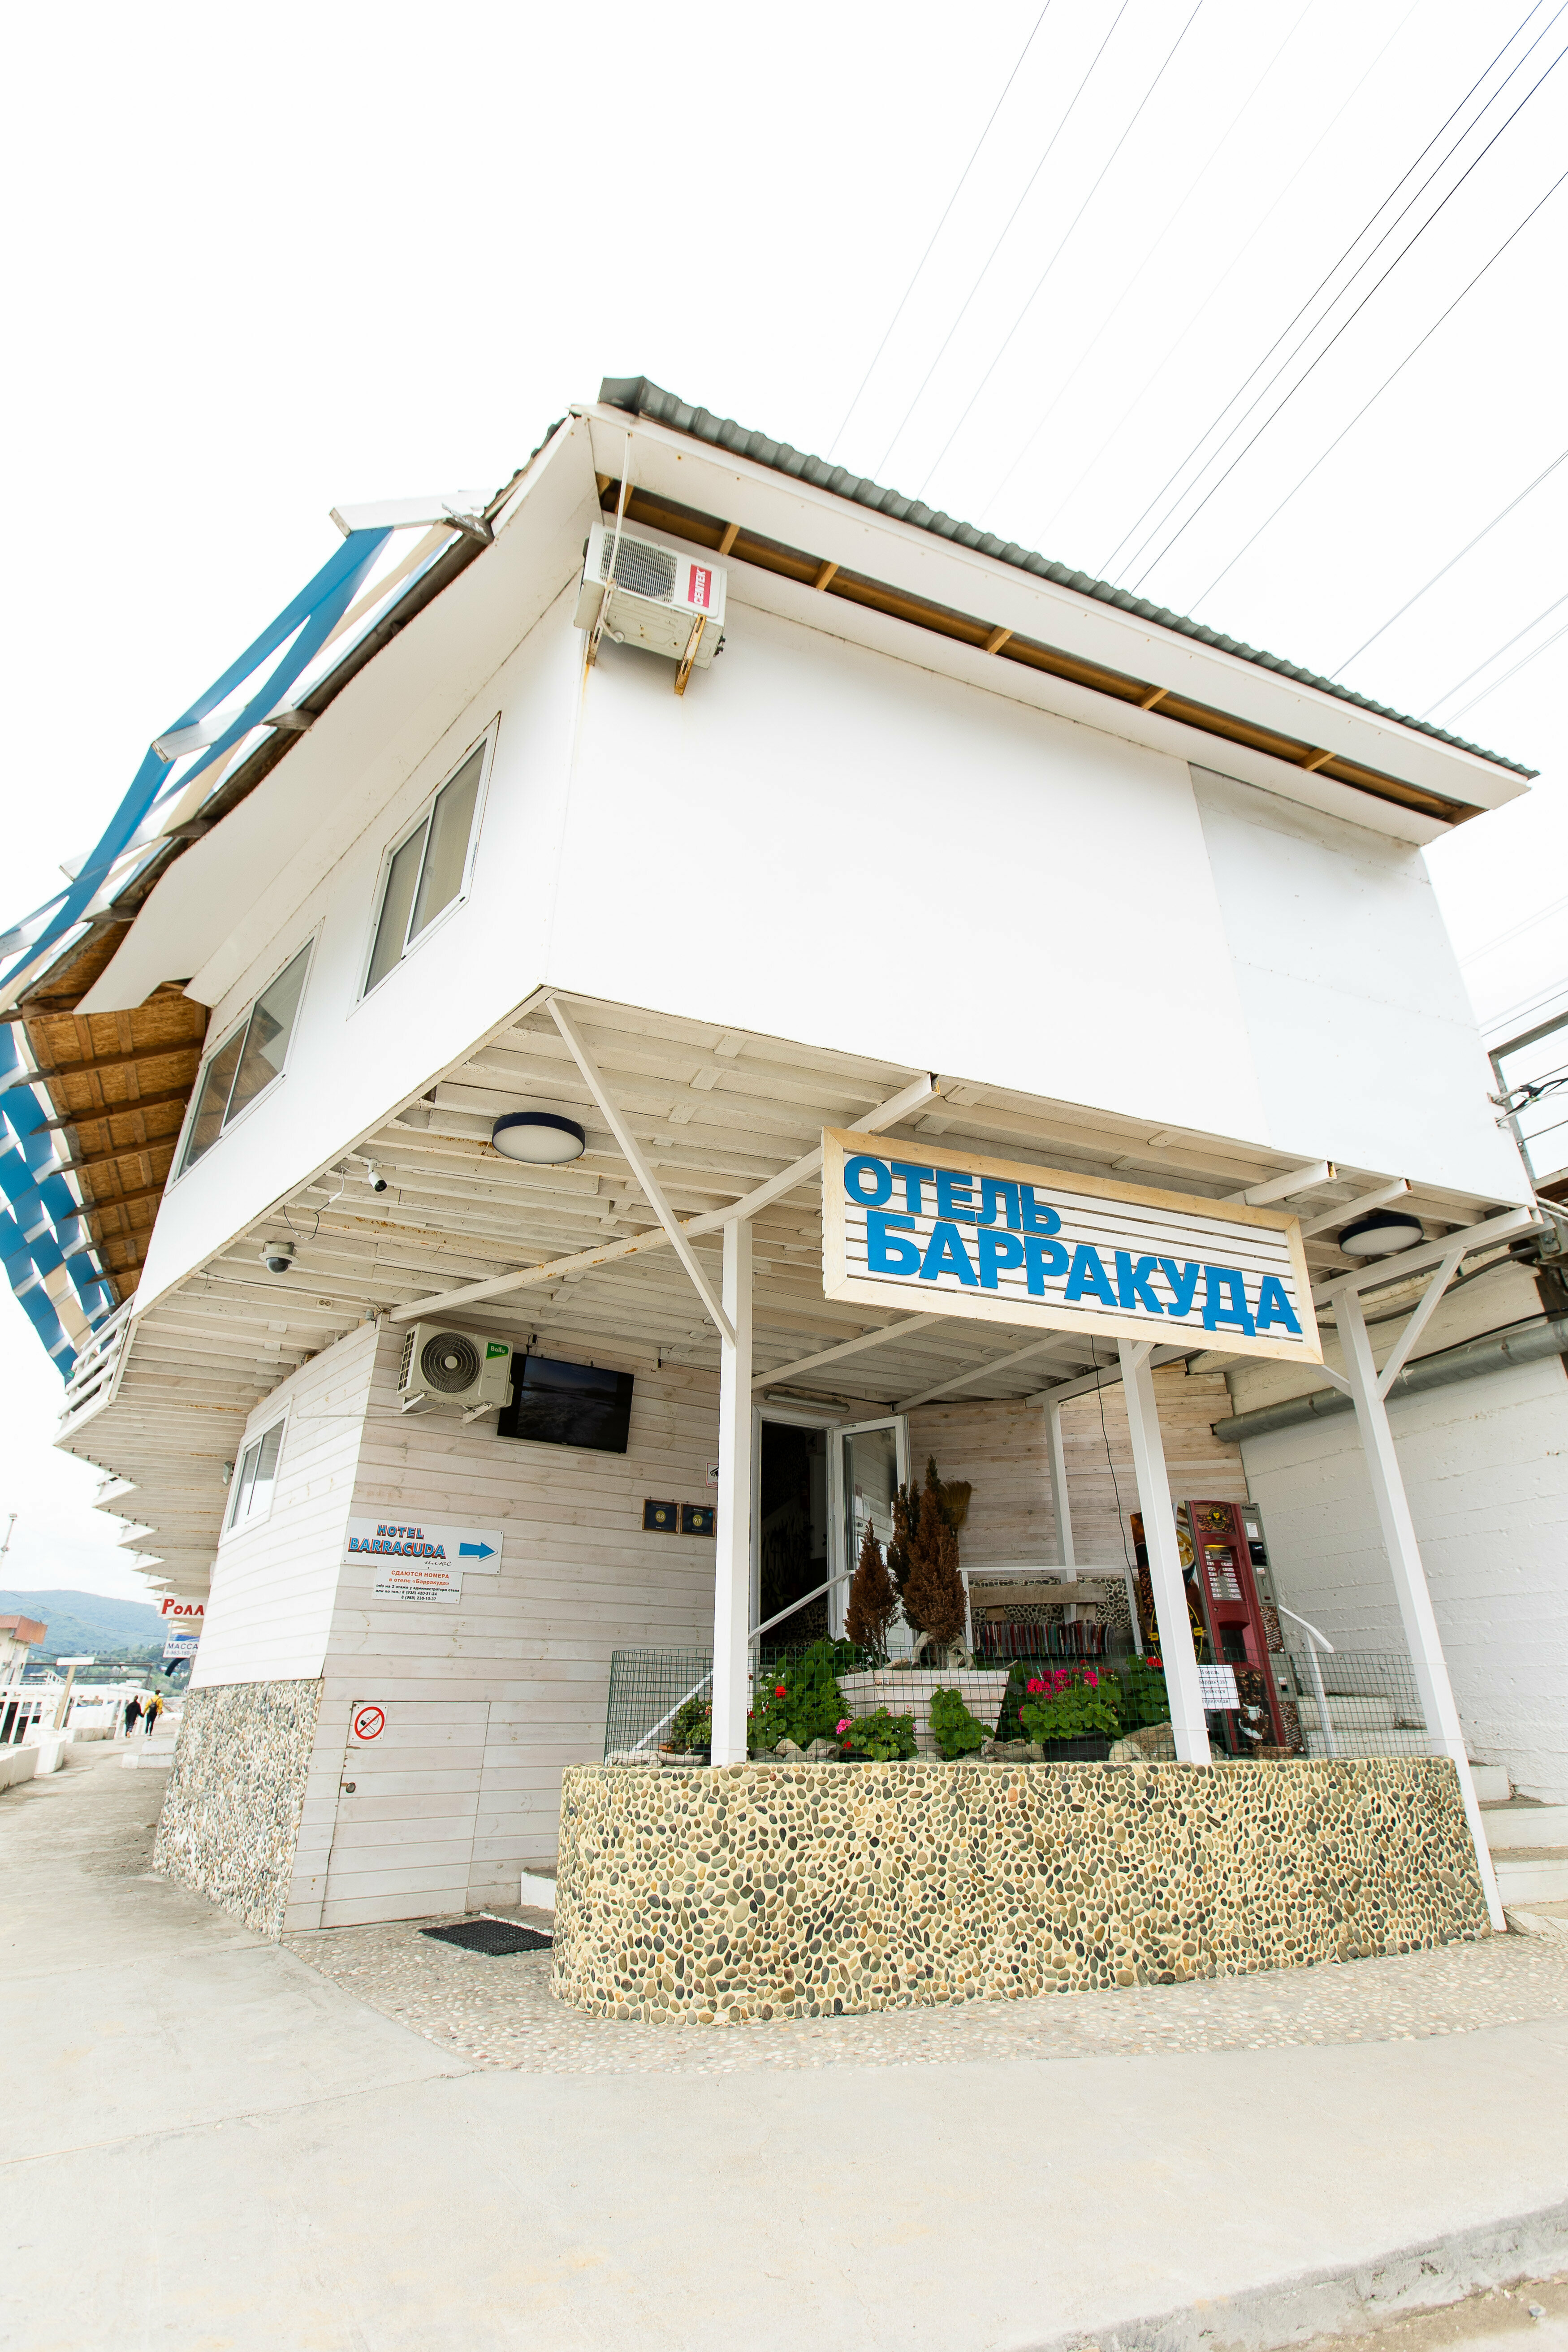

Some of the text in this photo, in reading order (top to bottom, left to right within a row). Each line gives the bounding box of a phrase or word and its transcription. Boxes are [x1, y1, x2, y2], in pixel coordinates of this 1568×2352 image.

[694, 567, 705, 605] CENTEK
[844, 1156, 1061, 1235] ОТЕЛЬ
[867, 1210, 1302, 1336] БАРРАКУДА
[348, 1537, 446, 1559] BARRACUDA
[376, 1525, 424, 1539] HOTEL
